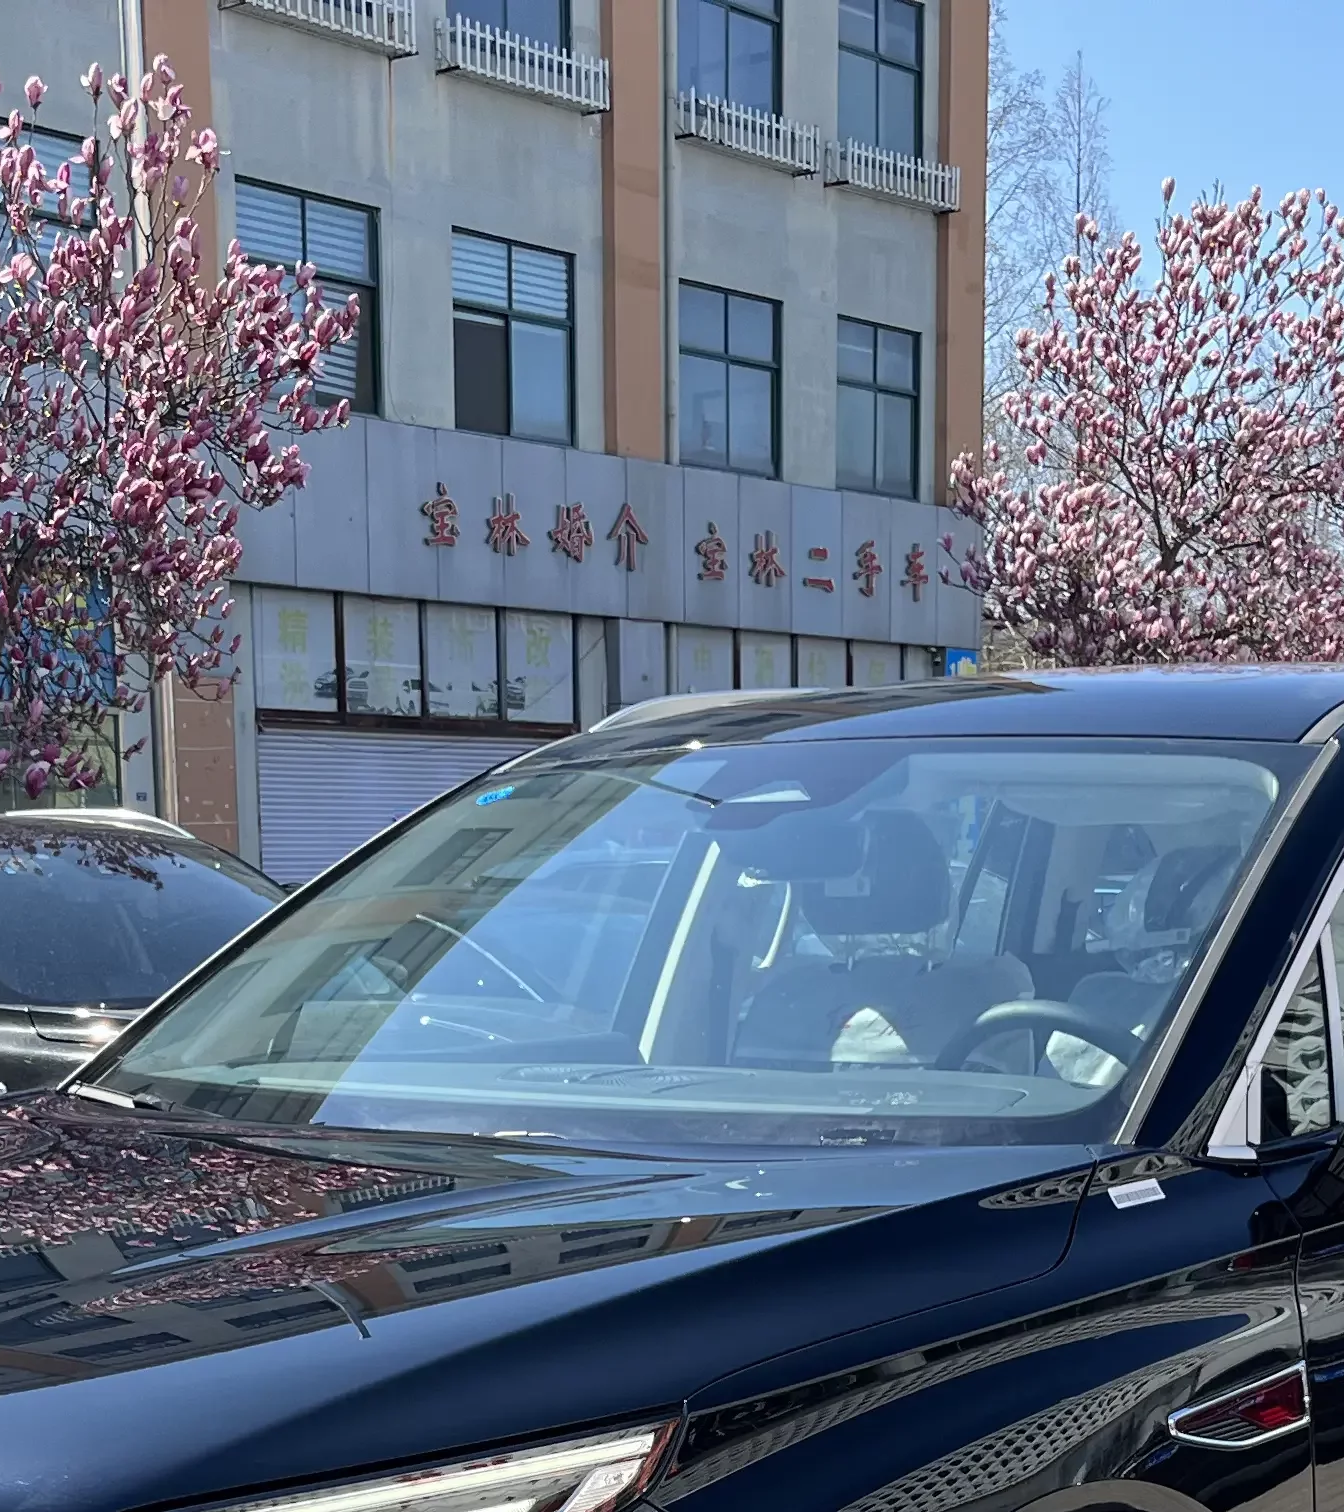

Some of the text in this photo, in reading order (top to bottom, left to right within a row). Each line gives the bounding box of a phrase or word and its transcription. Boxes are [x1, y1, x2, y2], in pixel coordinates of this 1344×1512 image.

[419, 480, 650, 573] 宝林婚介
[694, 520, 930, 603] 宝林二手车
